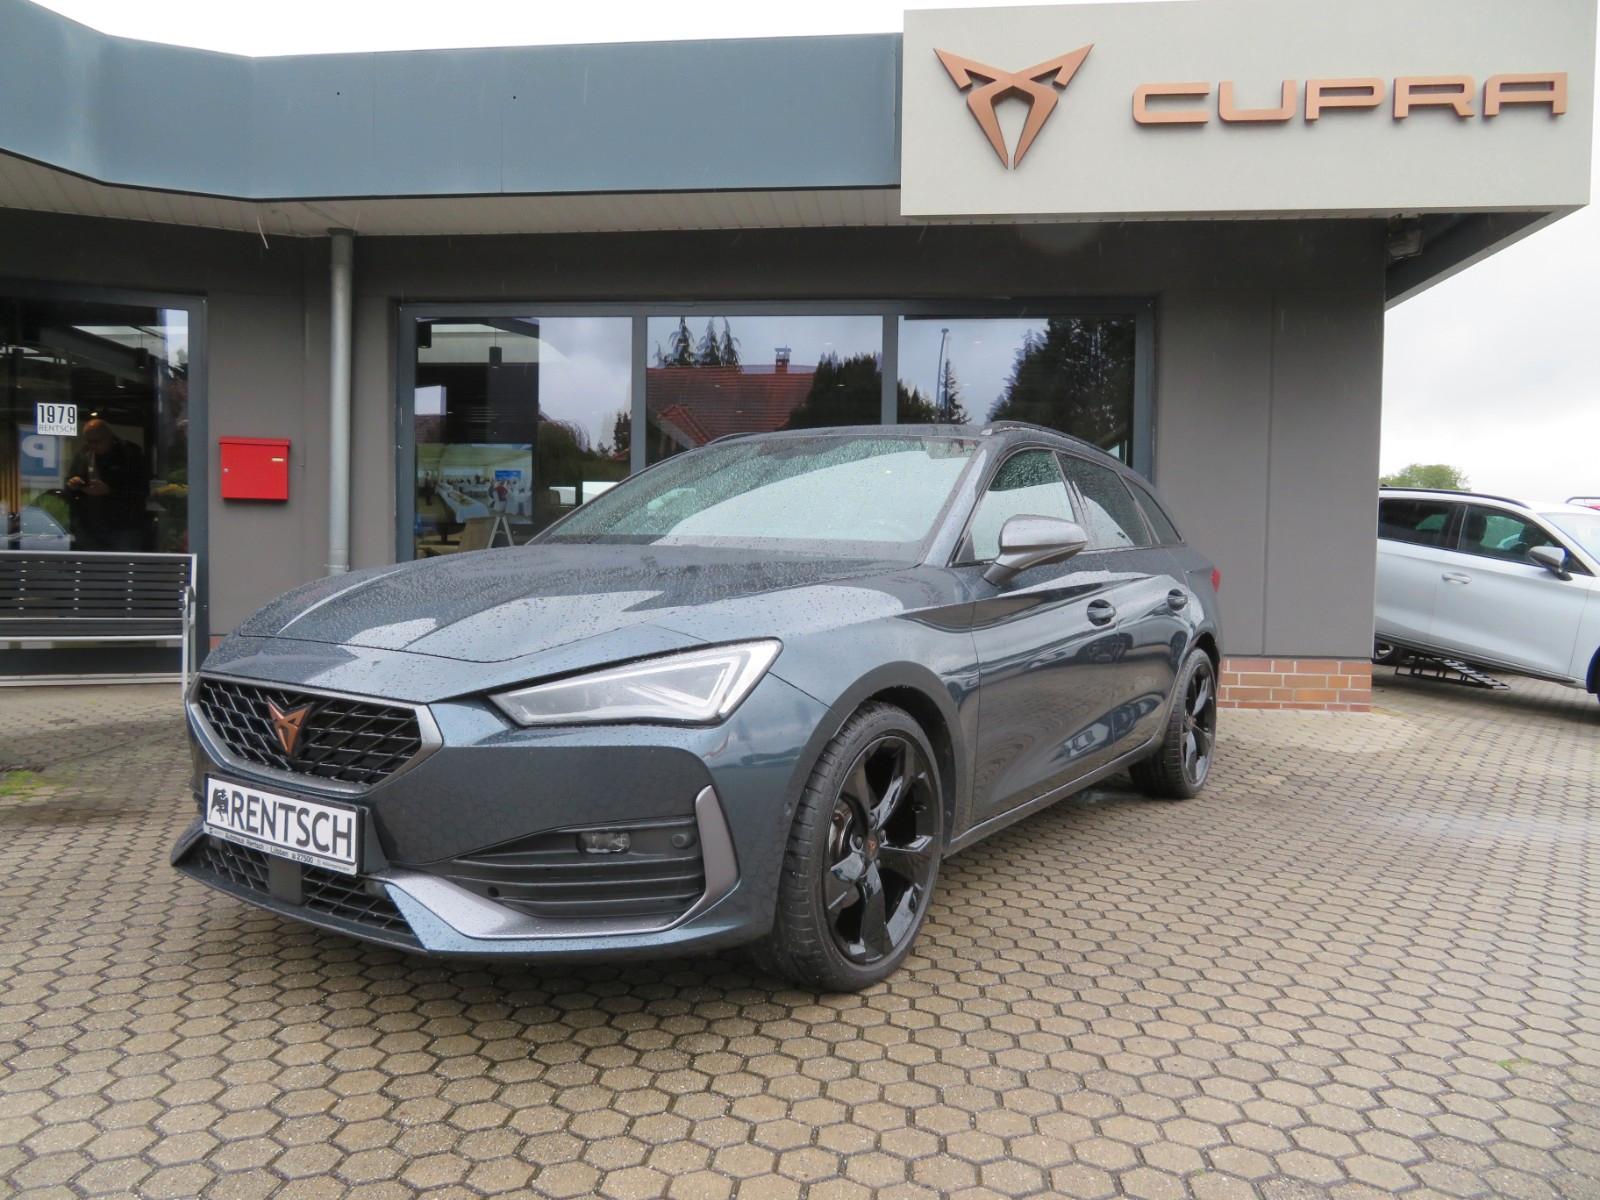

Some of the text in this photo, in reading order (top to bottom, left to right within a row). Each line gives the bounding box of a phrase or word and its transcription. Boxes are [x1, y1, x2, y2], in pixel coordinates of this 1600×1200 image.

[1132, 72, 1568, 125] CUPRA
[39, 405, 75, 424] 1979
[231, 790, 352, 859] RENTSCH
